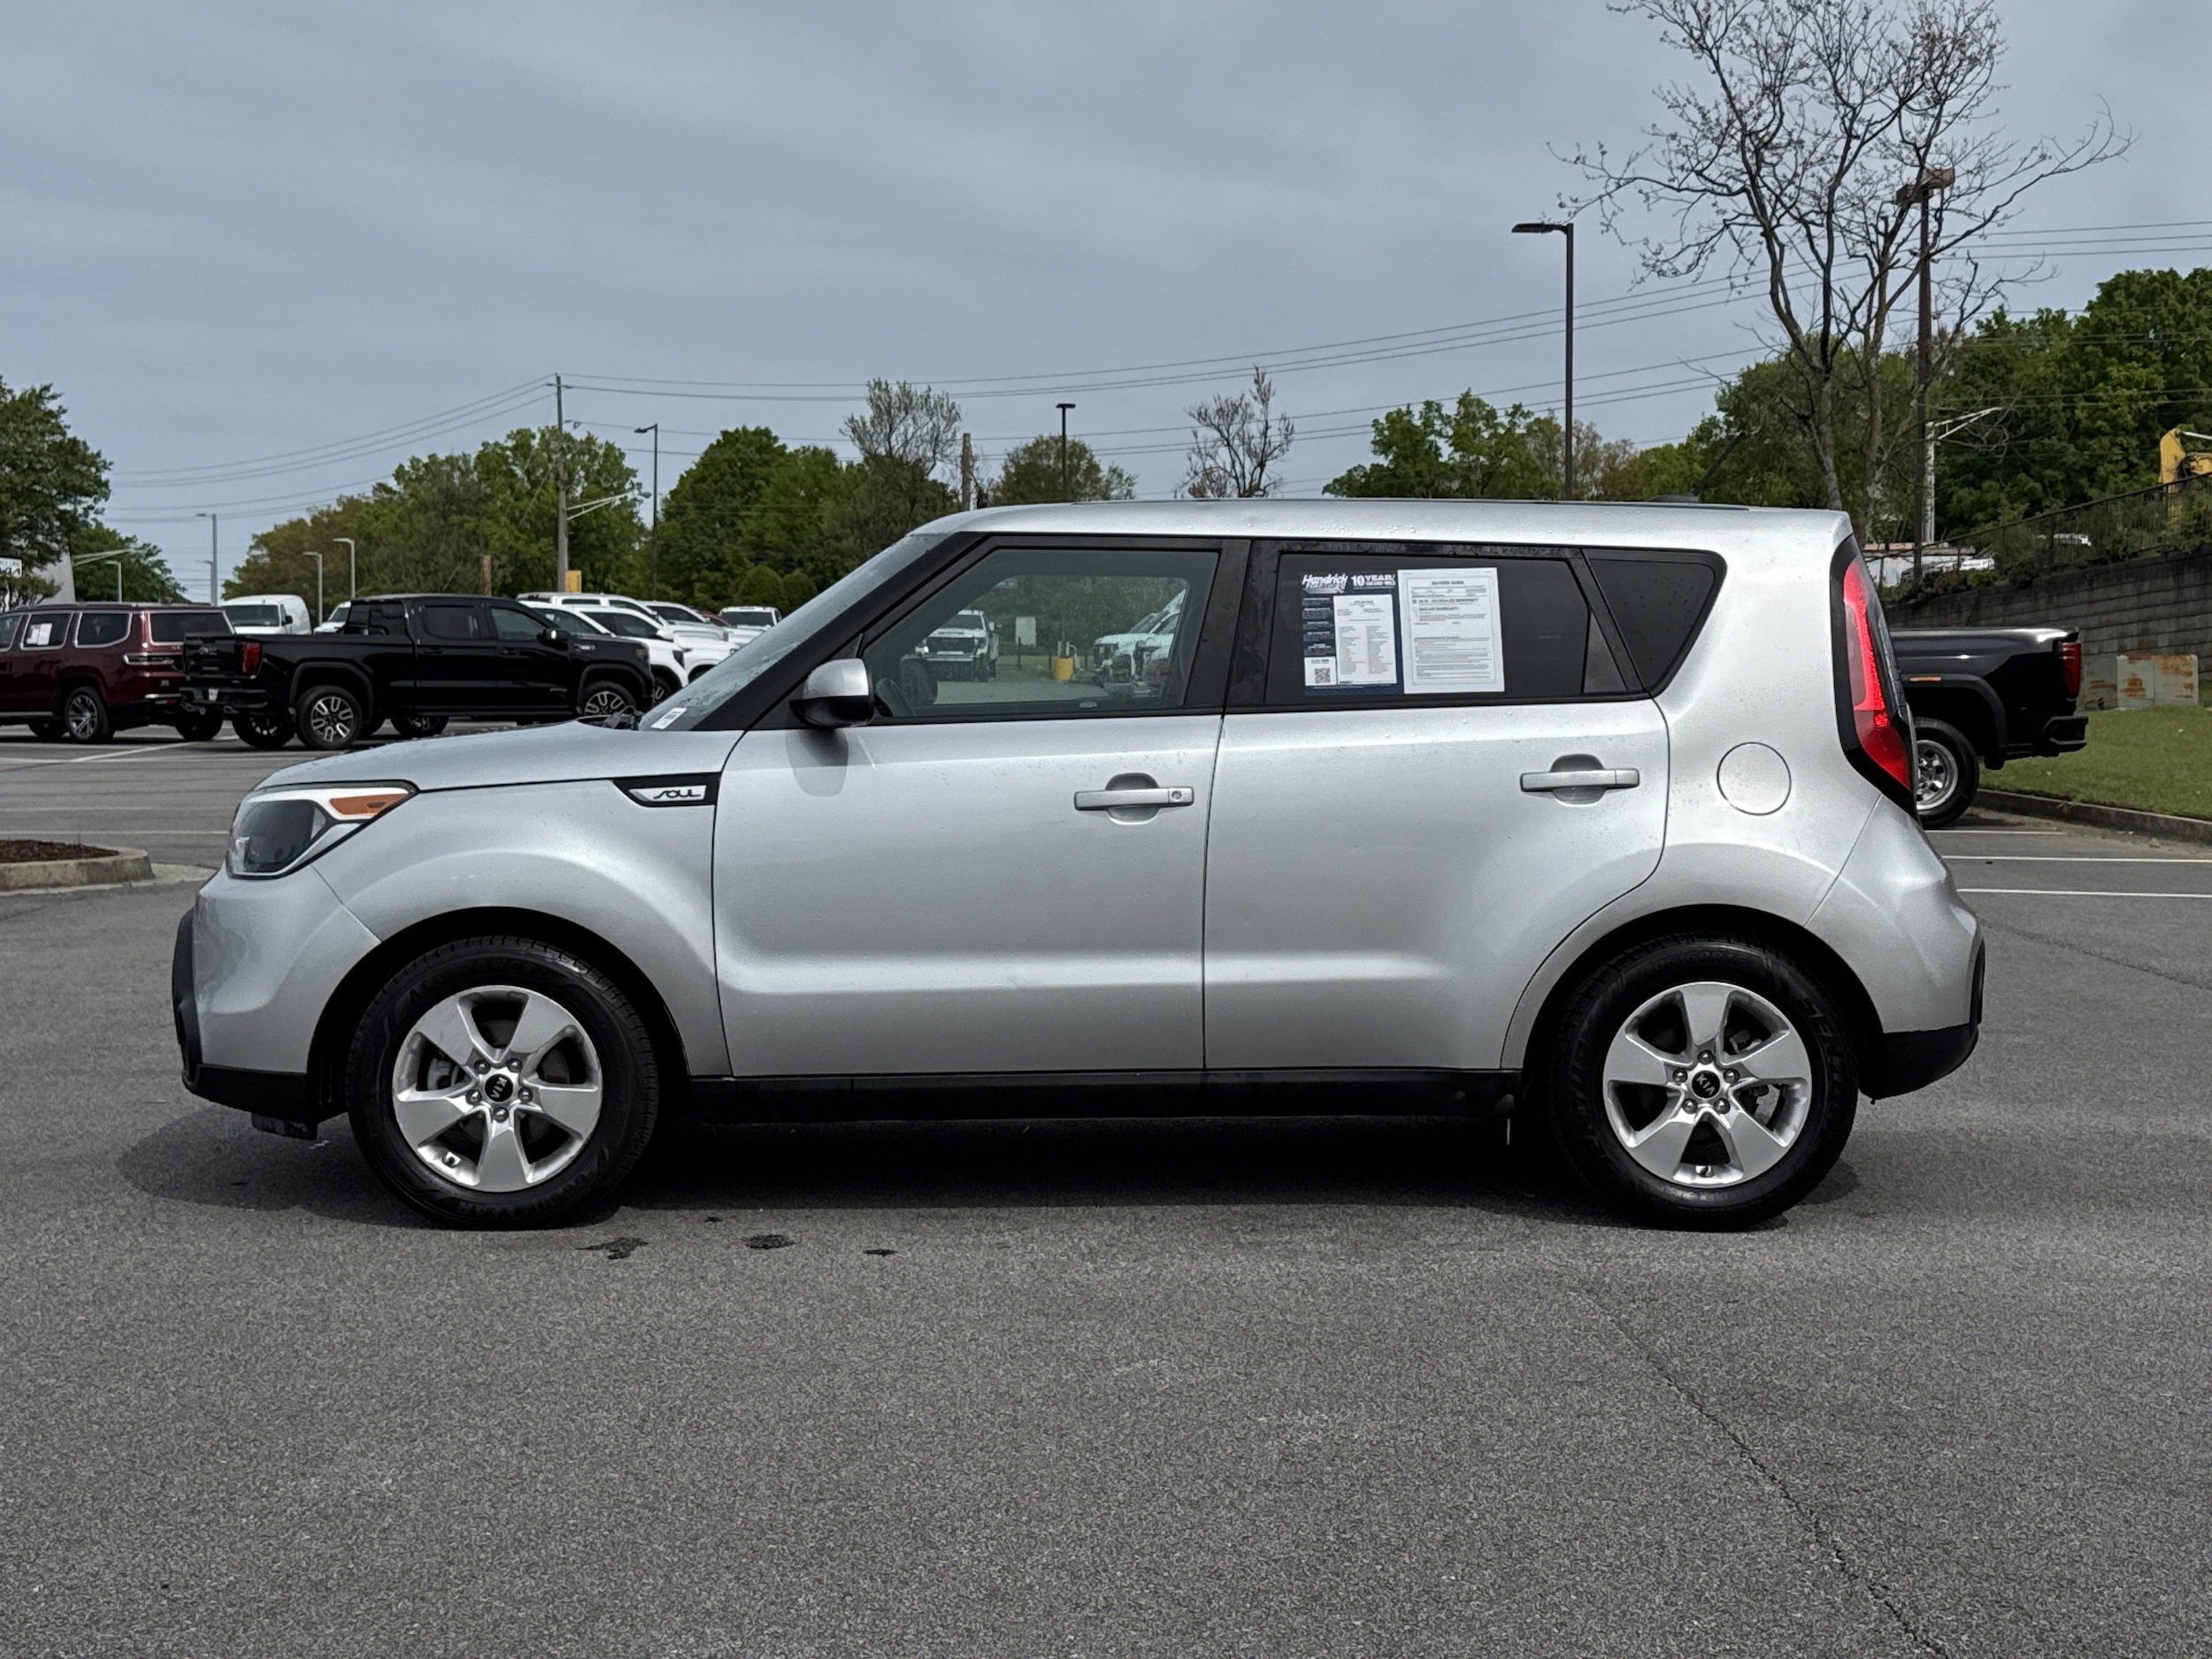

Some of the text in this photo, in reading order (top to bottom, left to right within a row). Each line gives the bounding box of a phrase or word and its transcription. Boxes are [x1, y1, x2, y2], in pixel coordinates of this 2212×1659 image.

[1302, 573, 1348, 588] Hendrick
[1351, 575, 1364, 587] 10
[654, 789, 701, 799] SOUL
[489, 1076, 508, 1099] KIA
[1696, 1073, 1716, 1096] KIA
